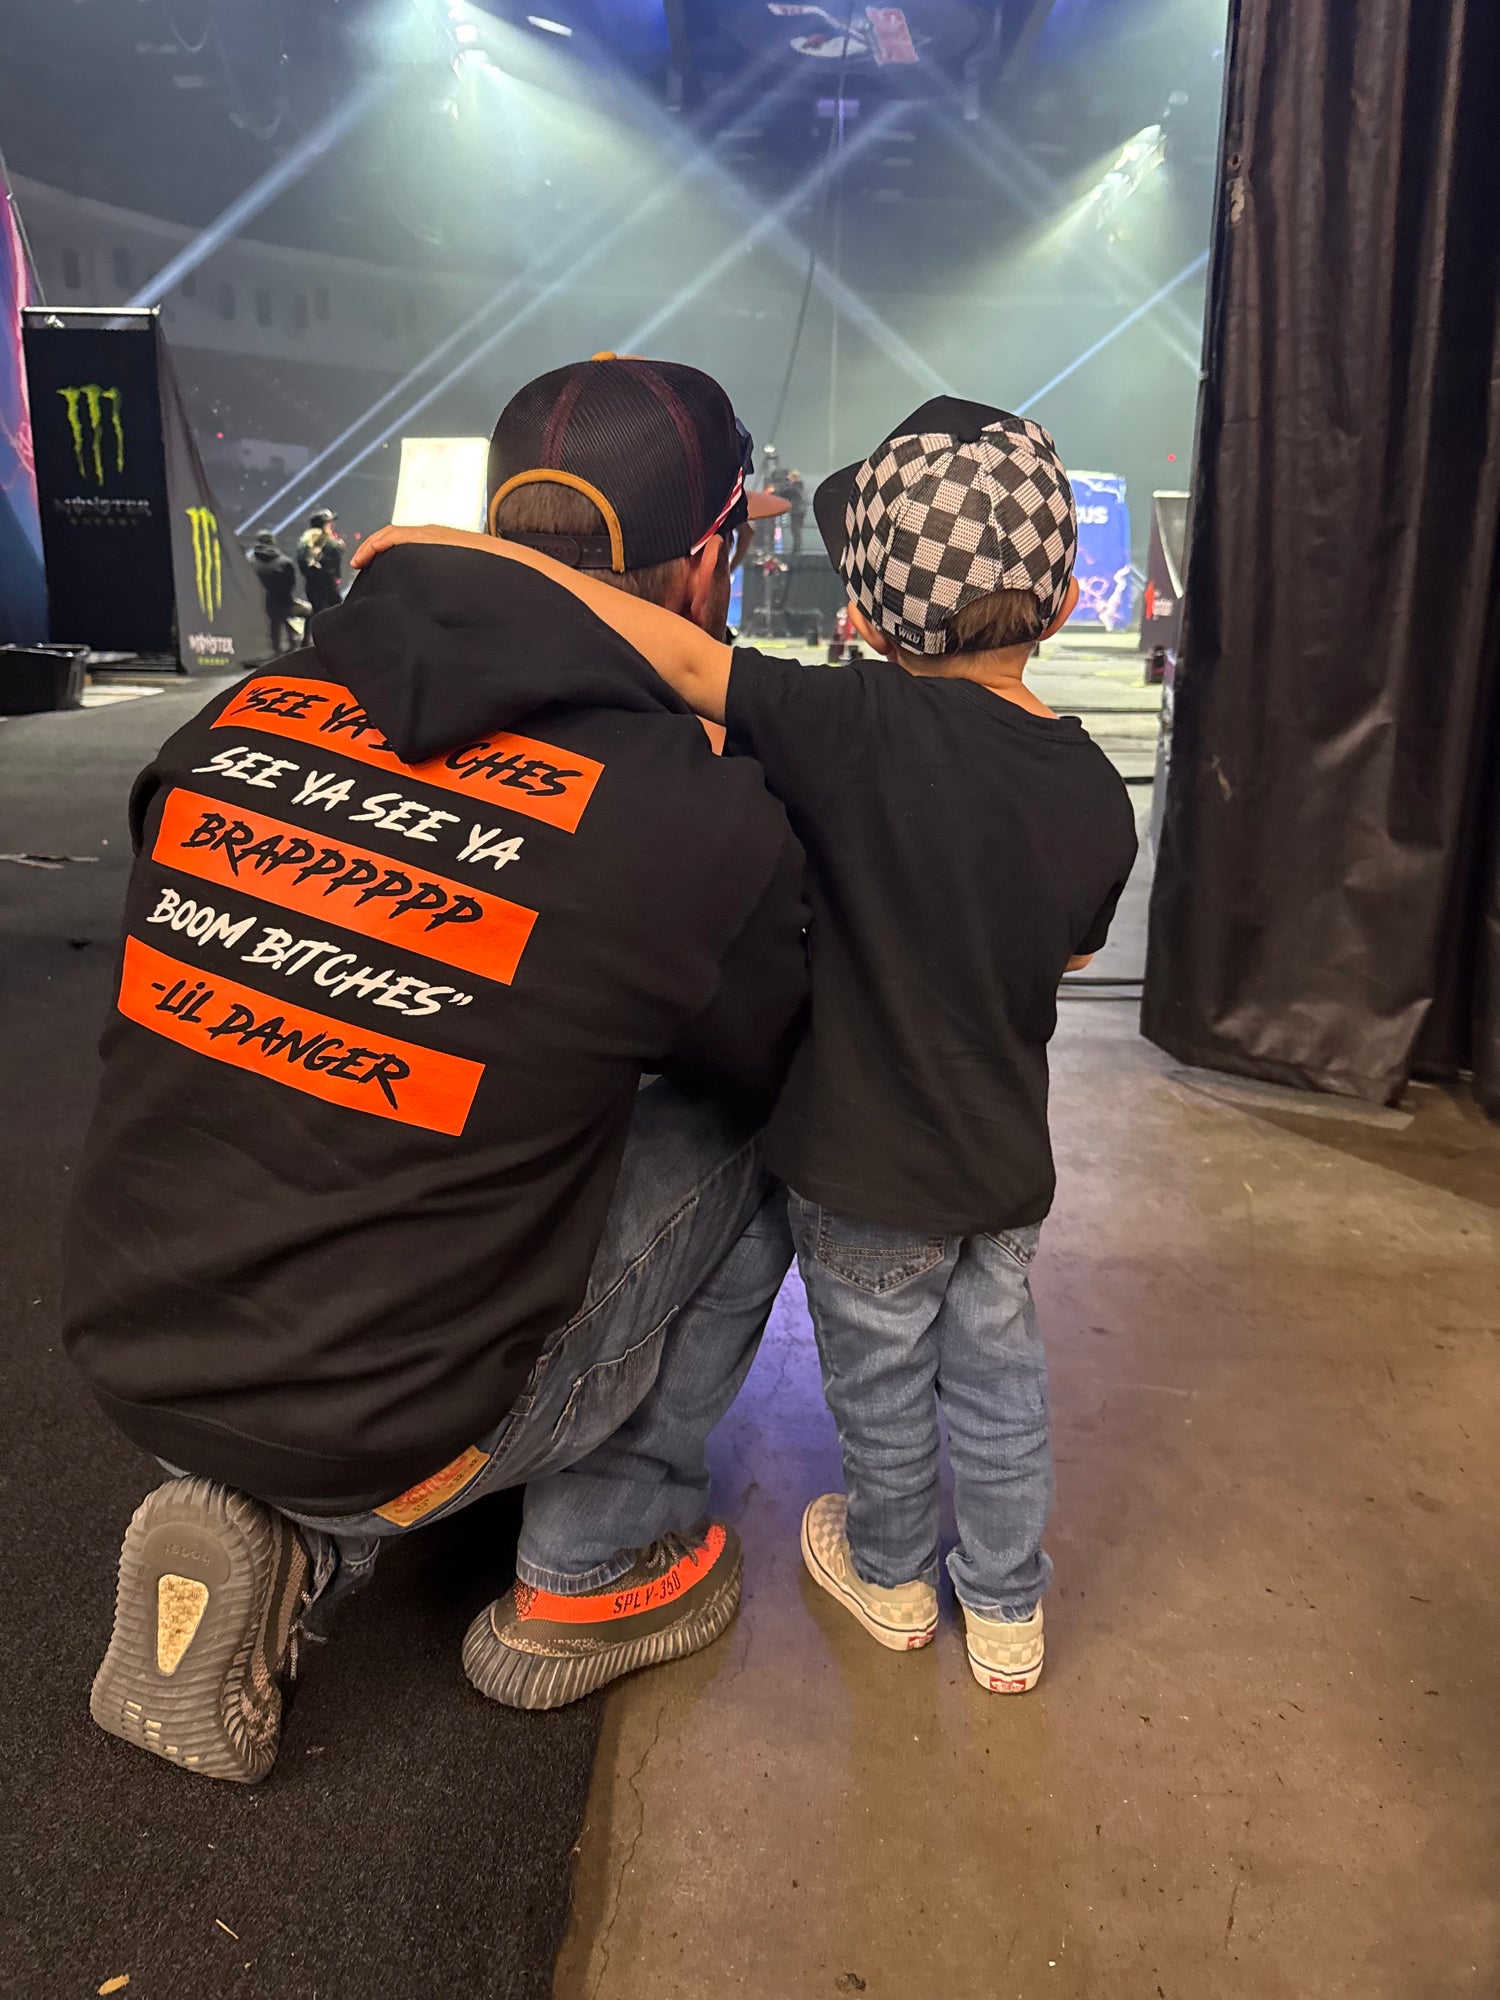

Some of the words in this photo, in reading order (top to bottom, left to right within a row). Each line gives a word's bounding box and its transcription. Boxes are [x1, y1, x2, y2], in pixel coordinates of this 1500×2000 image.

[191, 746, 301, 789] SEE
[290, 770, 356, 812] YA
[348, 792, 461, 843] SEE
[456, 823, 523, 872] YA
[146, 888, 258, 950] BOOM
[180, 812, 484, 933] BRAPPPPPP
[205, 1003, 411, 1111] DANGER
